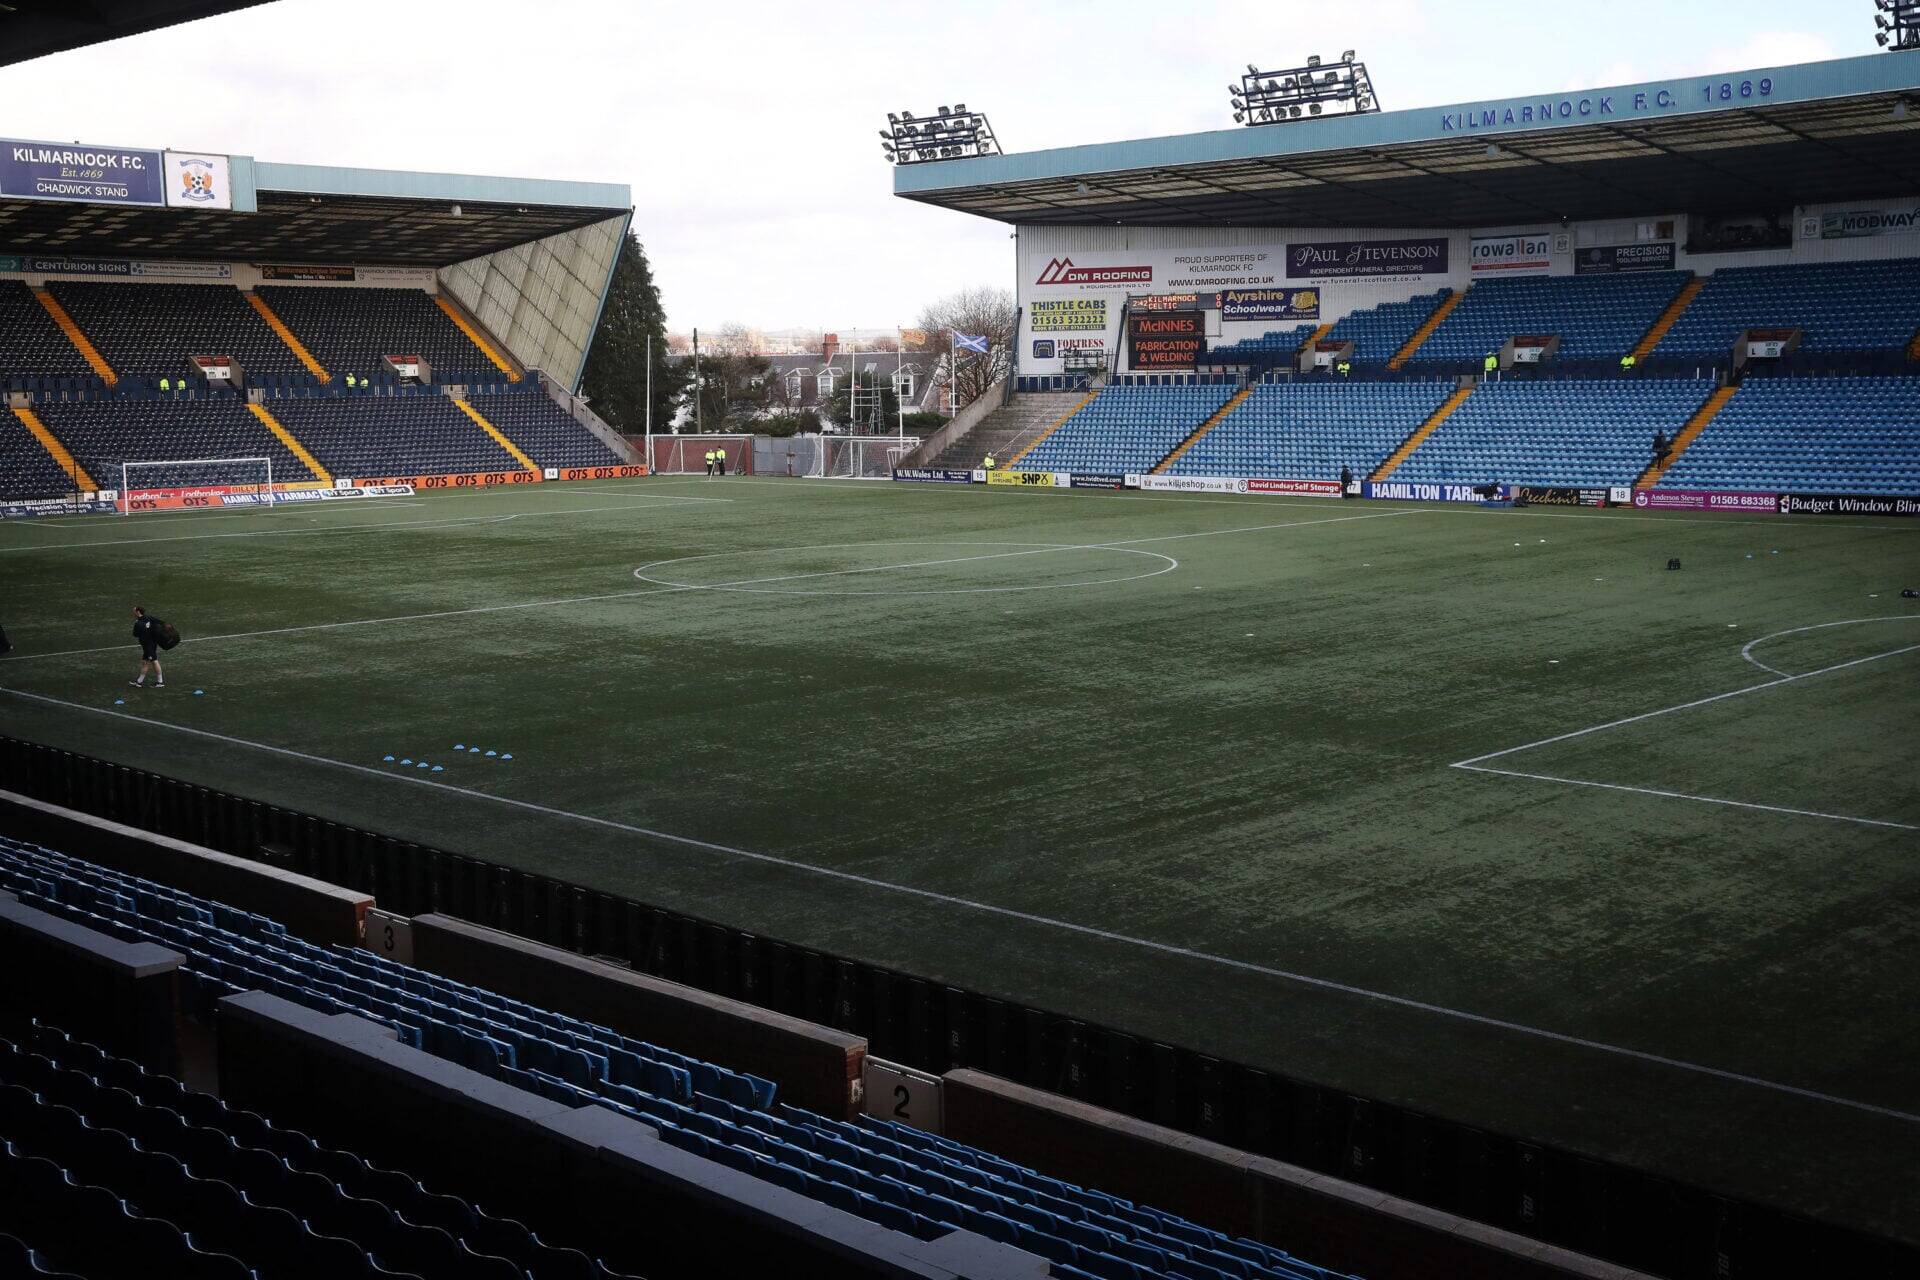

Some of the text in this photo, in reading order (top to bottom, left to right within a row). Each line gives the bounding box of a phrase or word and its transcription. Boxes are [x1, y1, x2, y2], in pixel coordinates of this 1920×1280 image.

[1443, 78, 1774, 131] KILMARNOCK F.C. 1869
[13, 148, 146, 170] KILMARNOCK F.C.
[61, 167, 104, 178] Est. 1869
[37, 183, 128, 198] CHADWICK STAND
[1841, 212, 1916, 230] MODWAY
[1472, 238, 1548, 258] rowallan
[1616, 246, 1670, 257] PRECISION
[1174, 256, 1202, 264] PROUD
[1204, 254, 1255, 263] SUPPORTERS
[36, 262, 127, 272] CENTURION SIGNS
[1189, 264, 1240, 272] KILMARNOCK
[1092, 271, 1150, 280] ROOFING
[1226, 290, 1284, 304] Ayrshire
[1032, 300, 1106, 310] THISTLE CABS
[1224, 304, 1286, 314] Schoolwear
[1032, 316, 1064, 324] 01563
[1140, 320, 1194, 332] McINNES
[1058, 339, 1104, 348] FORTRESS
[1136, 341, 1199, 351] FABRICATION
[1140, 352, 1194, 362] & WELDING
[568, 466, 640, 480] OTS OTS OTS
[896, 470, 931, 479] W.W.Wales
[932, 470, 945, 479] Ltd.
[1022, 473, 1040, 484] SNP
[395, 478, 418, 488] OTS
[426, 476, 447, 488] OTS
[456, 475, 477, 486] OTS
[484, 474, 505, 484] OTS
[513, 472, 534, 483] OTS
[1270, 482, 1295, 491] Lindsay
[1295, 482, 1308, 490] Self
[1310, 483, 1339, 493] Storage
[1371, 483, 1440, 500] HAMILTON
[222, 491, 320, 504] HAMILTON TARMAC
[1616, 491, 1625, 499] 18
[130, 497, 209, 509] OTS OTS
[1710, 496, 1775, 506] 01505 683368
[1791, 497, 1835, 513] Budget
[1839, 498, 1893, 512] Window
[384, 925, 394, 951] 3
[894, 1084, 910, 1119] 2
